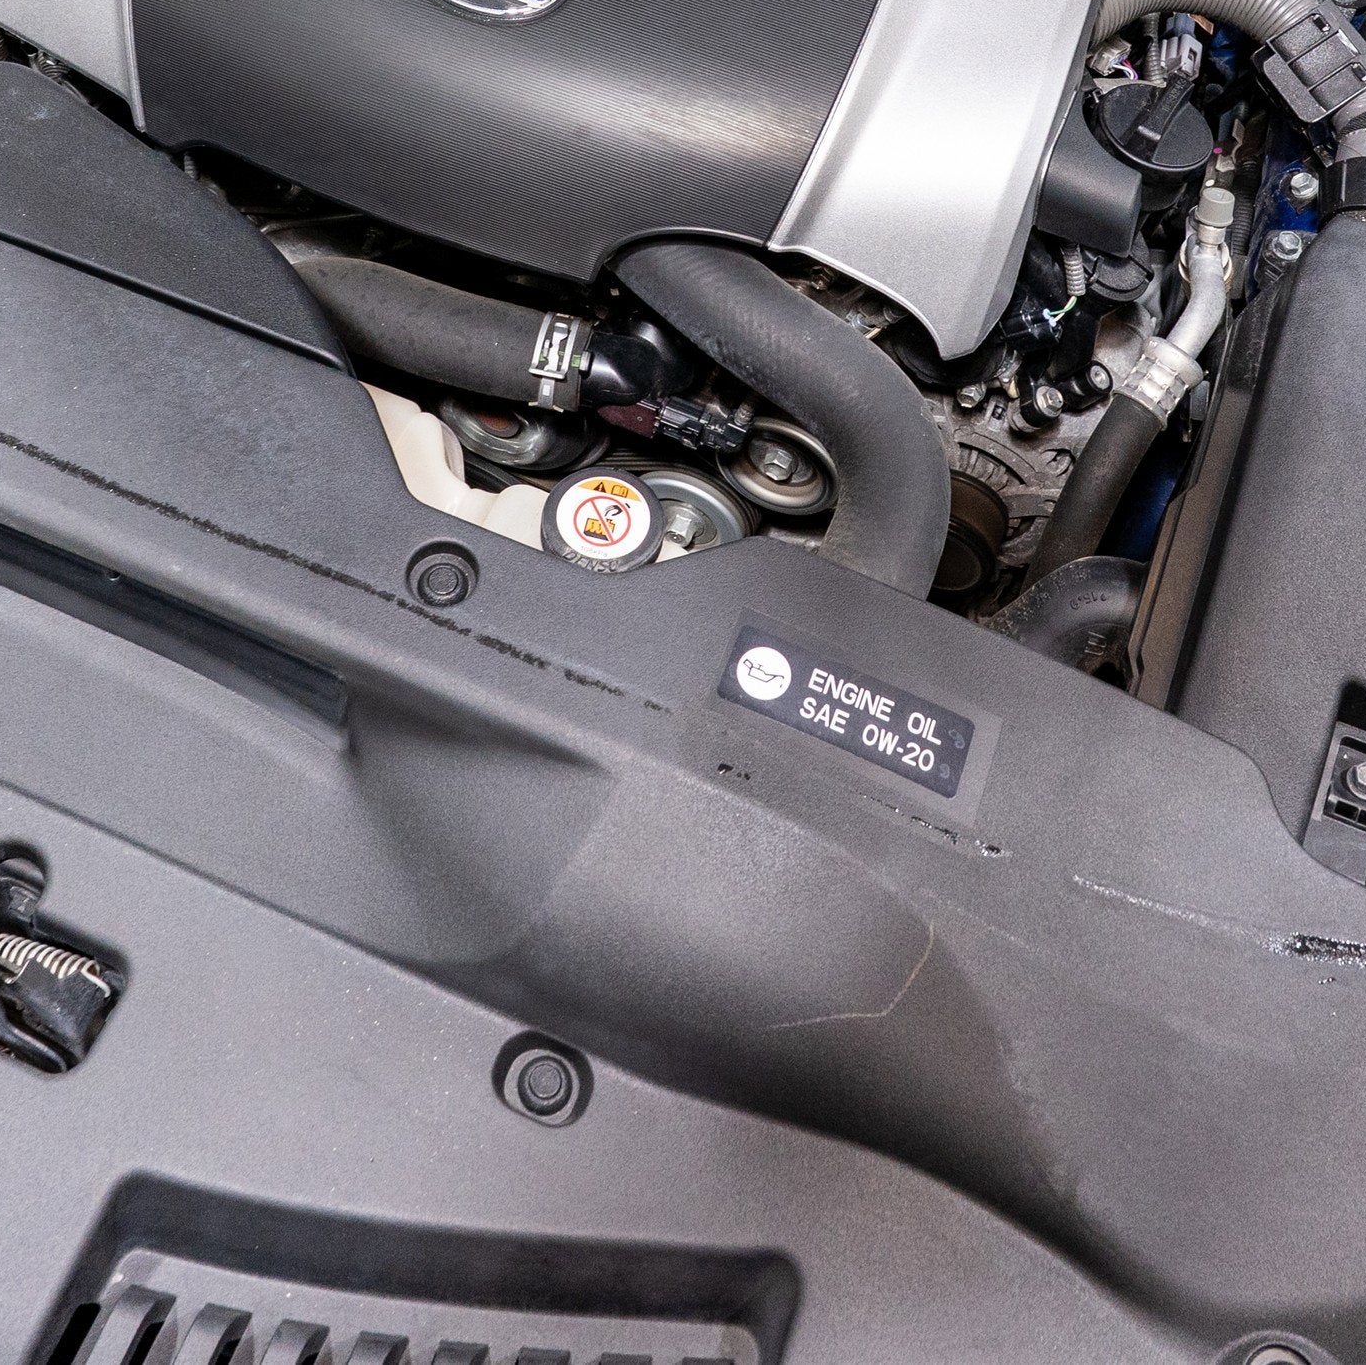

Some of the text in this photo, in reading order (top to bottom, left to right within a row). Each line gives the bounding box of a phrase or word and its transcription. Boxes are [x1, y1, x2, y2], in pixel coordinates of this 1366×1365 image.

[561, 547, 620, 573] DENSO
[799, 697, 936, 773] SAE 0W-20
[807, 667, 943, 746] ENGINE OIL
